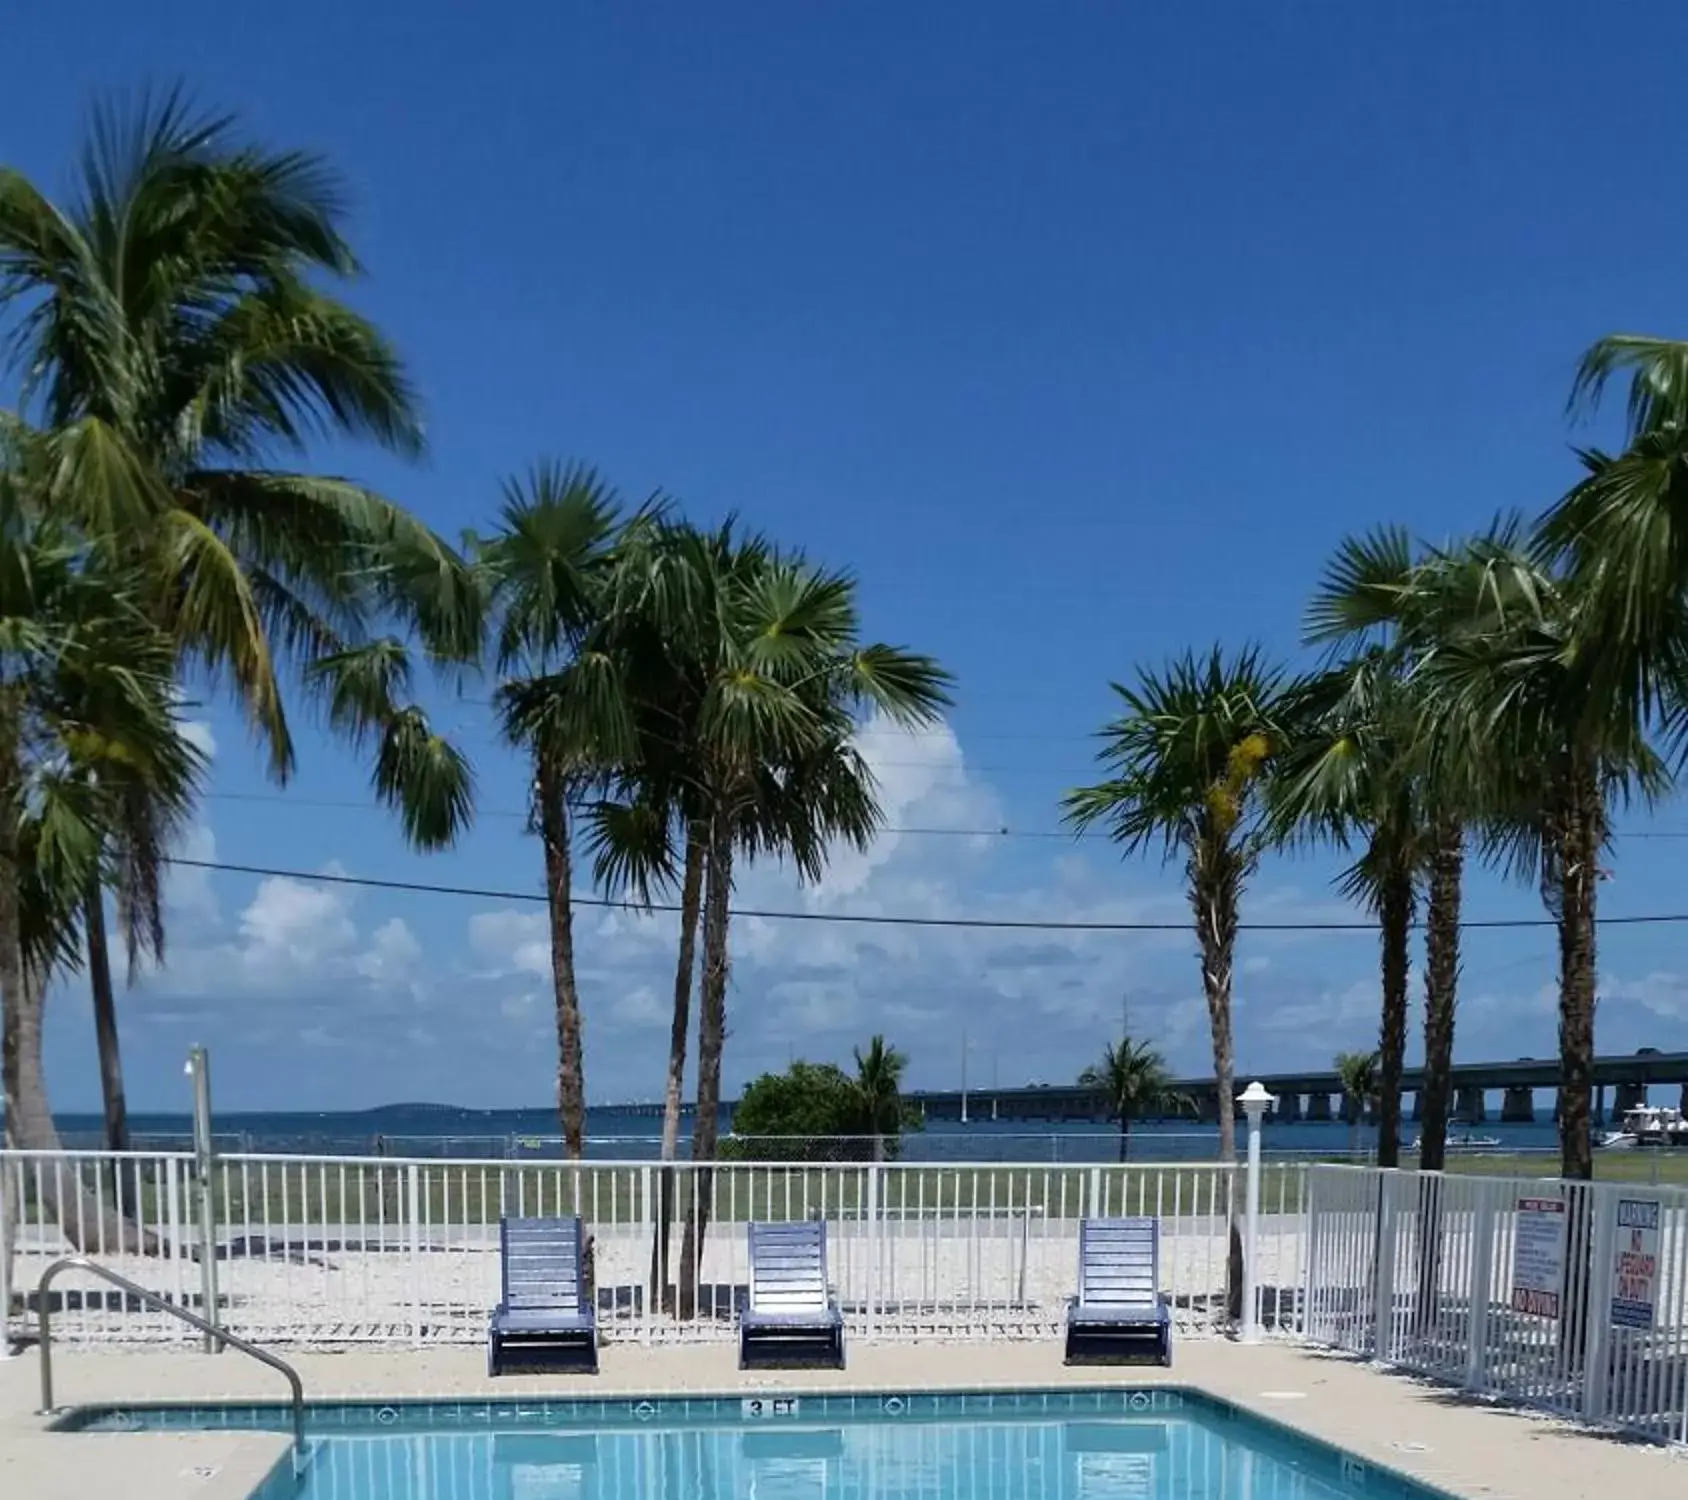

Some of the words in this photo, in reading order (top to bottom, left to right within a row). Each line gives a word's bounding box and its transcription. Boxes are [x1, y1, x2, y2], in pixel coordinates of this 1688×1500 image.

[1513, 1290, 1527, 1312] NO
[1528, 1291, 1558, 1318] DIVING
[751, 1400, 763, 1417] 3
[773, 1399, 795, 1417] FT
